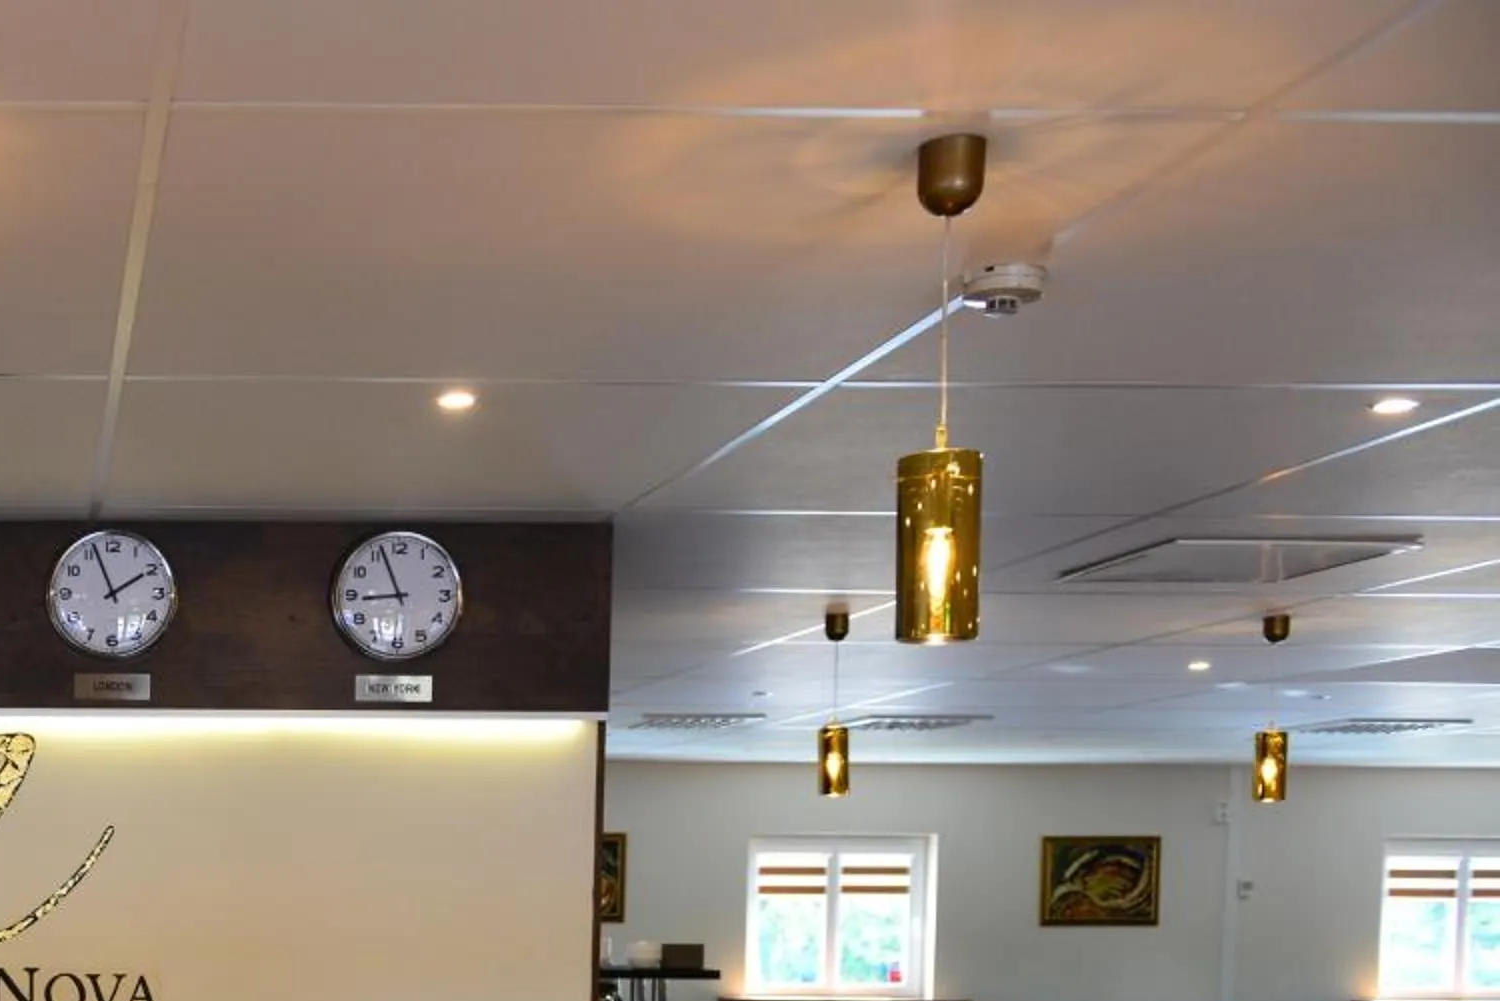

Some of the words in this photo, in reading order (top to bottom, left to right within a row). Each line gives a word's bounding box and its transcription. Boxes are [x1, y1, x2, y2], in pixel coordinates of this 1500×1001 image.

[106, 541, 121, 553] 12
[391, 542, 408, 555] 12
[84, 548, 94, 561] 11
[371, 550, 380, 563] 11
[67, 565, 80, 577] 10
[146, 563, 158, 576] 2
[353, 566, 366, 578] 10
[432, 566, 445, 578] 2
[60, 587, 72, 600] 9
[152, 587, 165, 600] 3
[344, 589, 358, 601] 9
[438, 589, 451, 603] 3
[146, 610, 157, 621] 4
[353, 612, 365, 625] 8
[431, 612, 443, 625] 4
[86, 627, 95, 641] 7
[415, 629, 427, 643] 5
[106, 635, 119, 647] 6
[93, 680, 133, 691] LONDON
[367, 682, 391, 692] NEW
[394, 682, 421, 692] YORK
